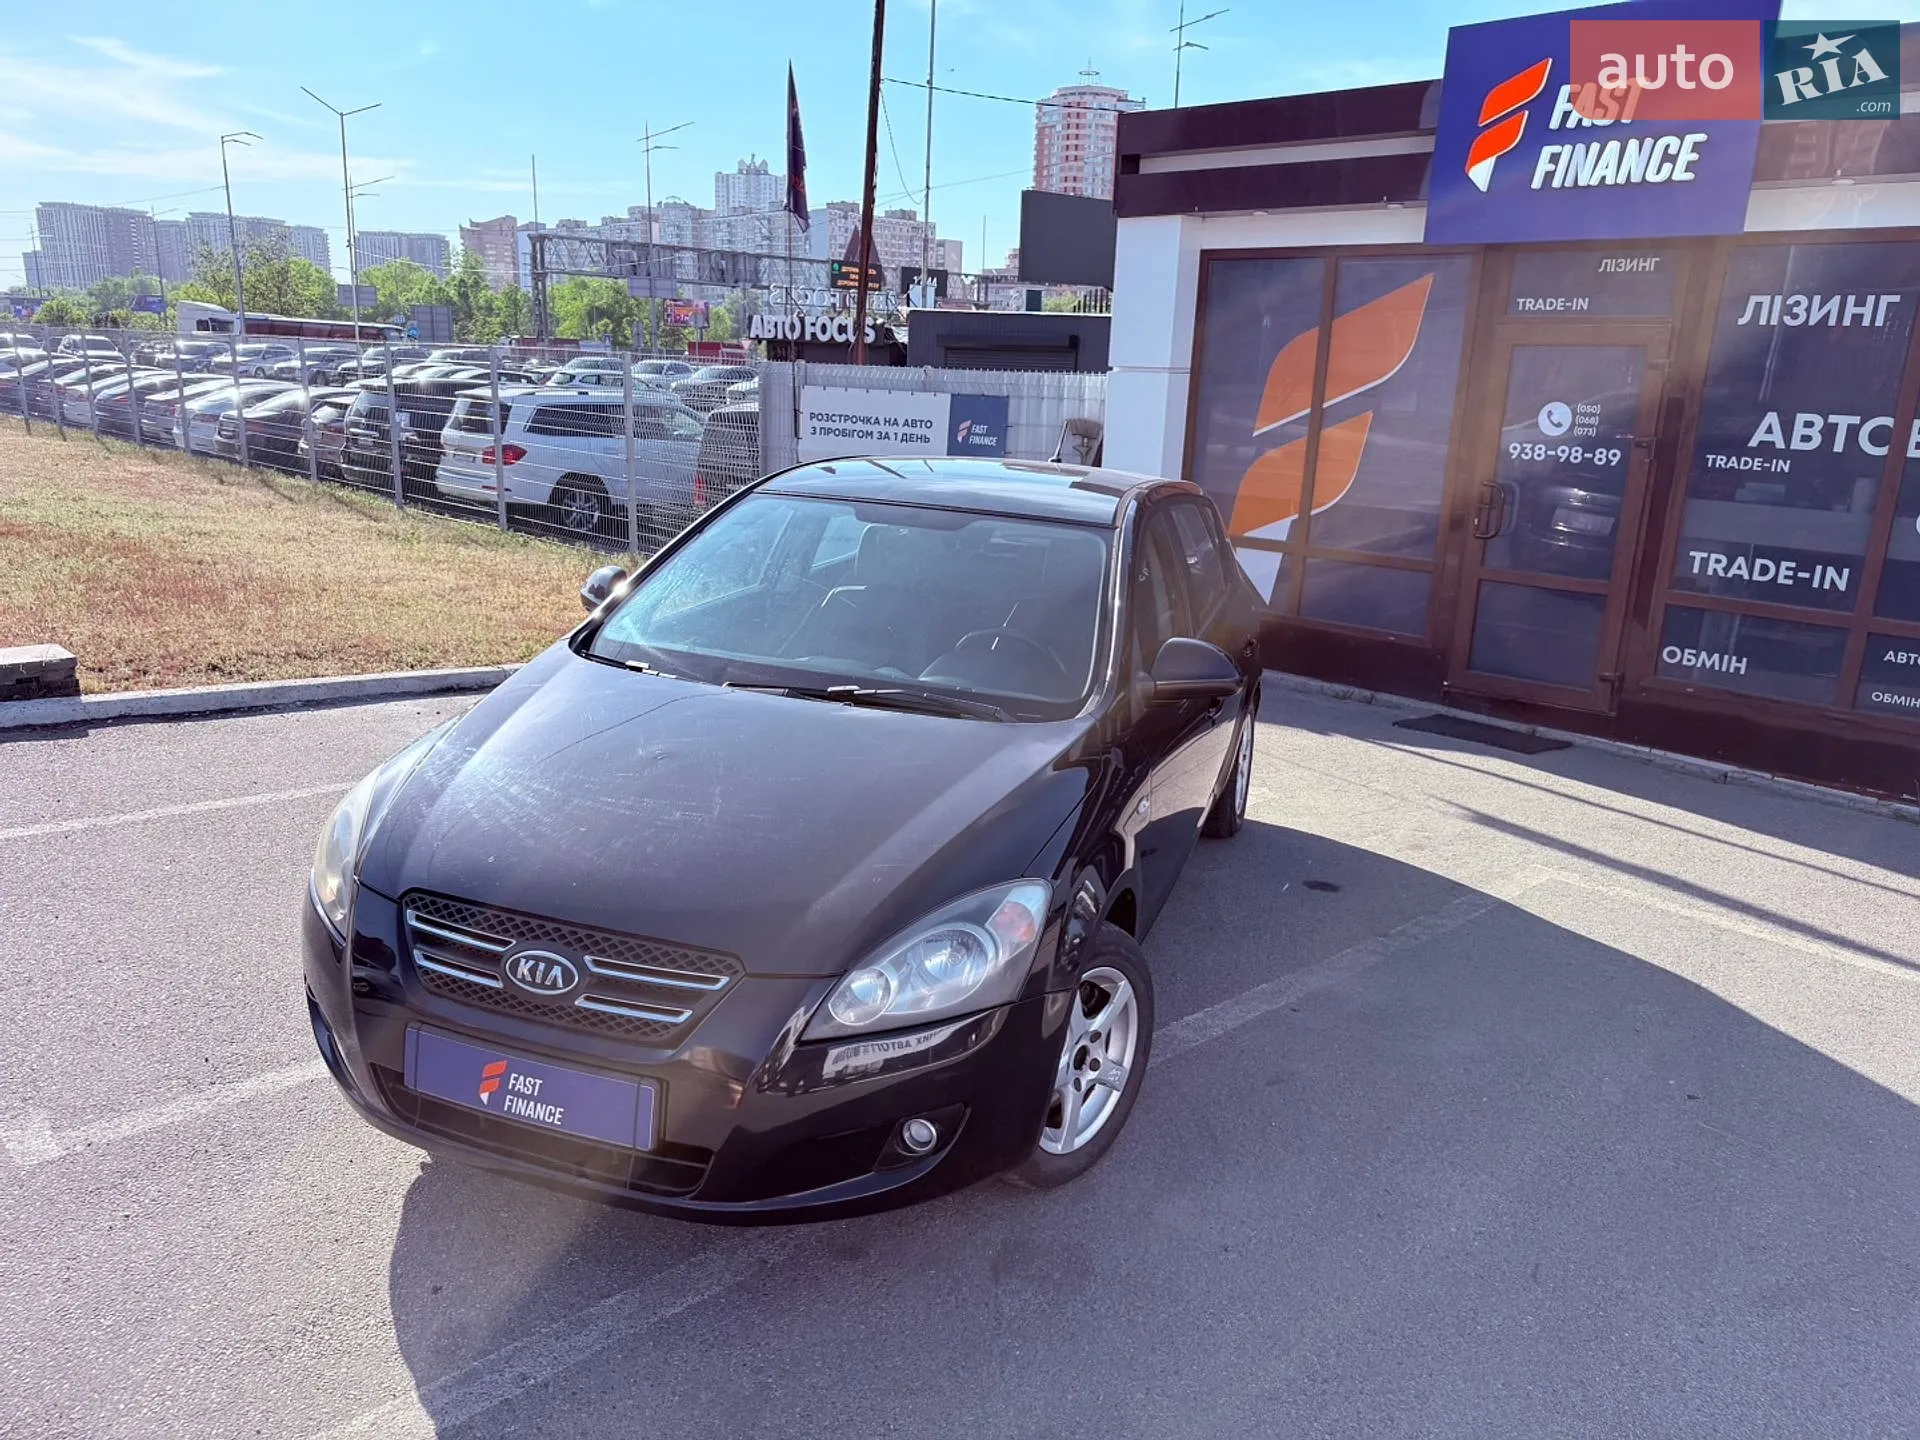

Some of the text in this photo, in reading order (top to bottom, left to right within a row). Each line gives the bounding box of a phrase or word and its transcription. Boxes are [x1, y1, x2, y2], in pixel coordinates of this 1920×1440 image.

[1549, 77, 1652, 130] FAST
[1530, 133, 1708, 190] FINANCE
[1598, 257, 1660, 273] ЛІЗИНГ
[1516, 297, 1589, 312] TRADE-IN
[1736, 294, 1901, 327] ЛІЗИНГ
[749, 313, 877, 344] АВТО FOCUS
[809, 412, 933, 429] РОЗСТРОЧКА НА АВТО
[819, 428, 874, 440] ПРОБІГОМ
[876, 431, 890, 441] ЗА
[893, 433, 898, 441] 1
[900, 432, 931, 444] ДЕНЬ
[969, 436, 998, 447] FINANCE
[1508, 442, 1621, 466] 938-98-89
[1706, 454, 1791, 473] TRADE-IN
[1689, 550, 1850, 592] TRADE-IN
[1662, 646, 1748, 675] ОБМІН
[1883, 650, 1920, 666] АВТ
[516, 957, 564, 988] KIA
[508, 1073, 543, 1096] FAST
[503, 1095, 564, 1125] FINANCE
